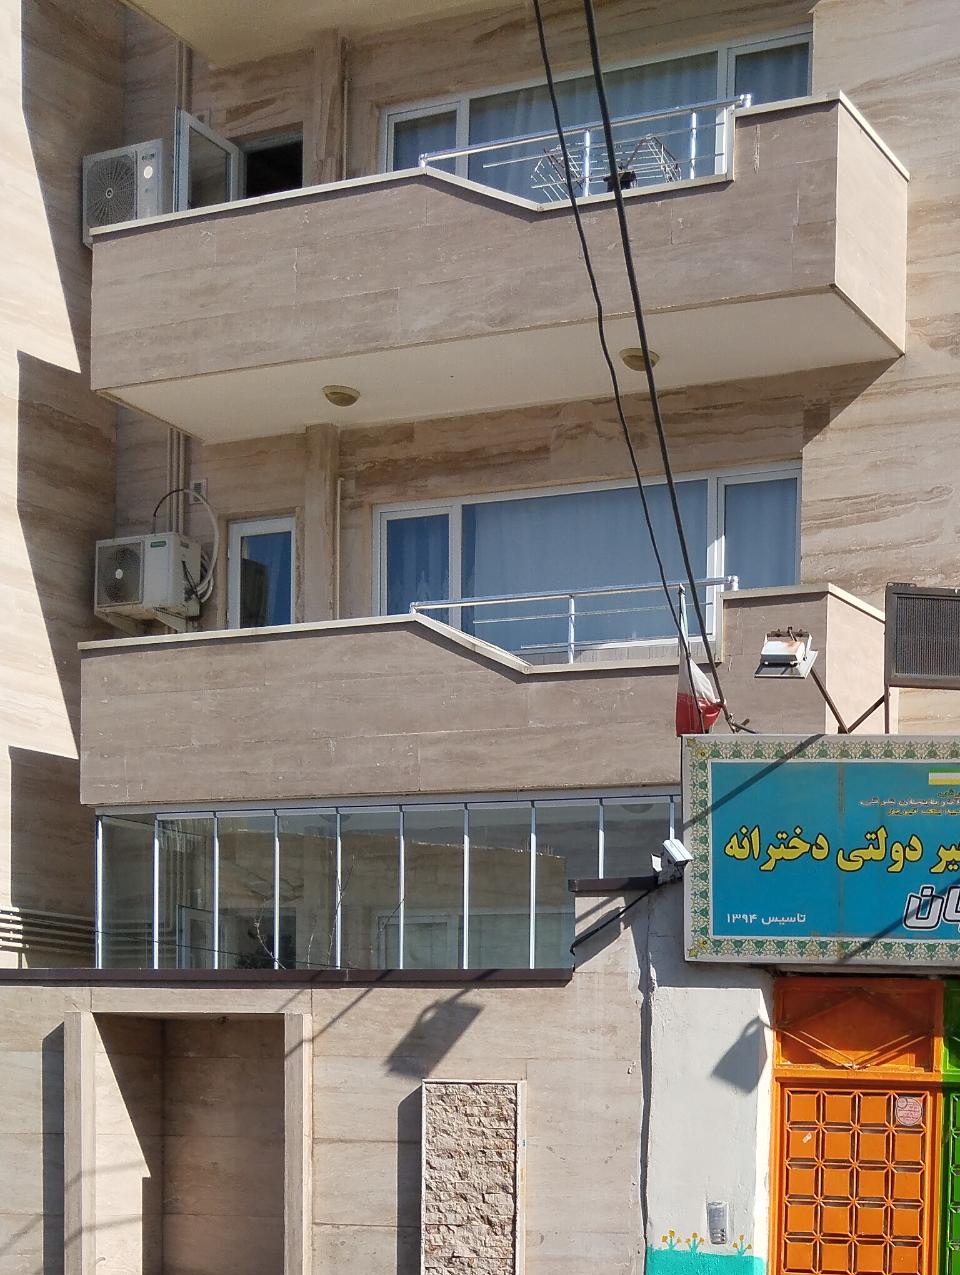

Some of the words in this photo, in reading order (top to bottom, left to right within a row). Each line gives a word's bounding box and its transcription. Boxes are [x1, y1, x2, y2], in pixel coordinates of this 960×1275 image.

[724, 825, 830, 872] دخترانه
[836, 825, 924, 873] دولتی
[727, 913, 758, 924] ۱۳۹۴
[761, 913, 806, 926] تاسیس
